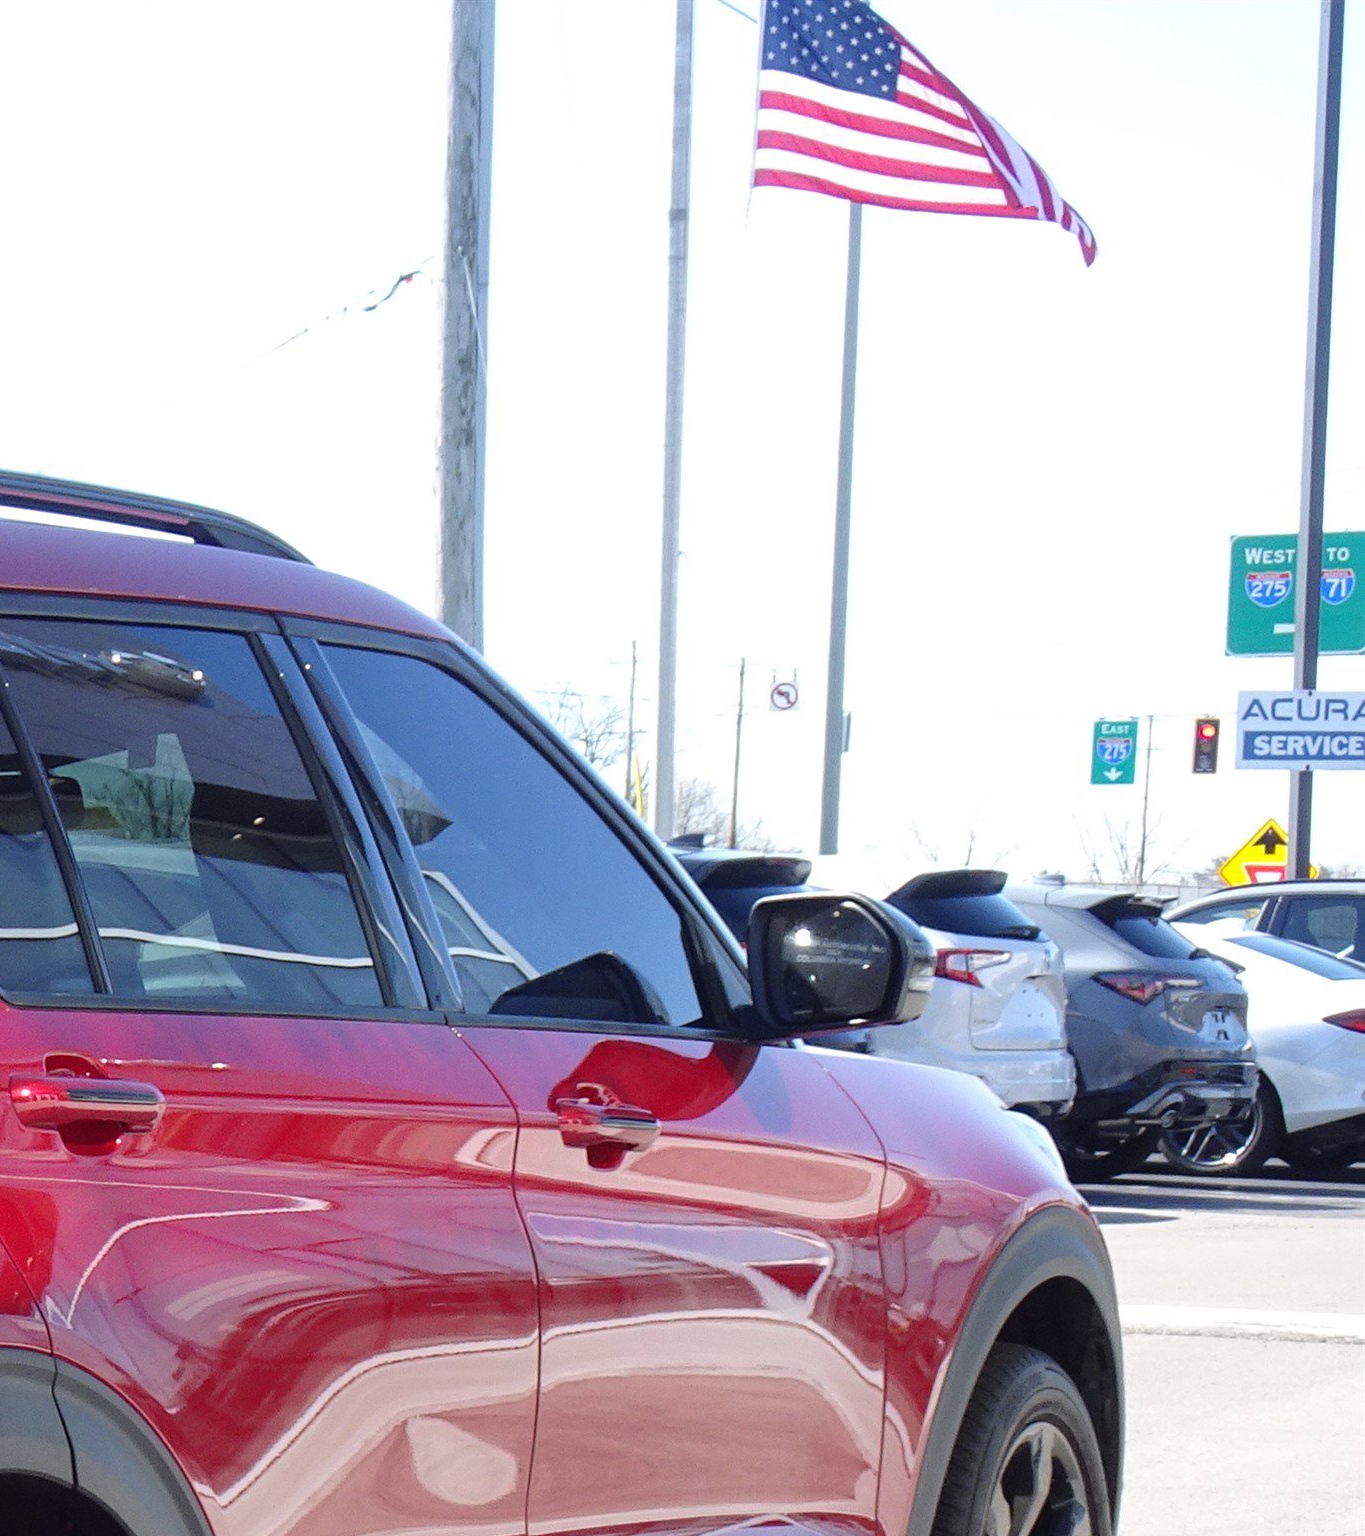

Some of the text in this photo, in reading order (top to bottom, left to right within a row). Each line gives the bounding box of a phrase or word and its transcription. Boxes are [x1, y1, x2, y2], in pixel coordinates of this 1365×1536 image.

[1244, 546, 1350, 565] WEST TO
[1251, 578, 1347, 598] 275 71
[1102, 724, 1129, 735] EAST
[1105, 743, 1127, 760] 275
[1253, 735, 1365, 757] SERVICE
